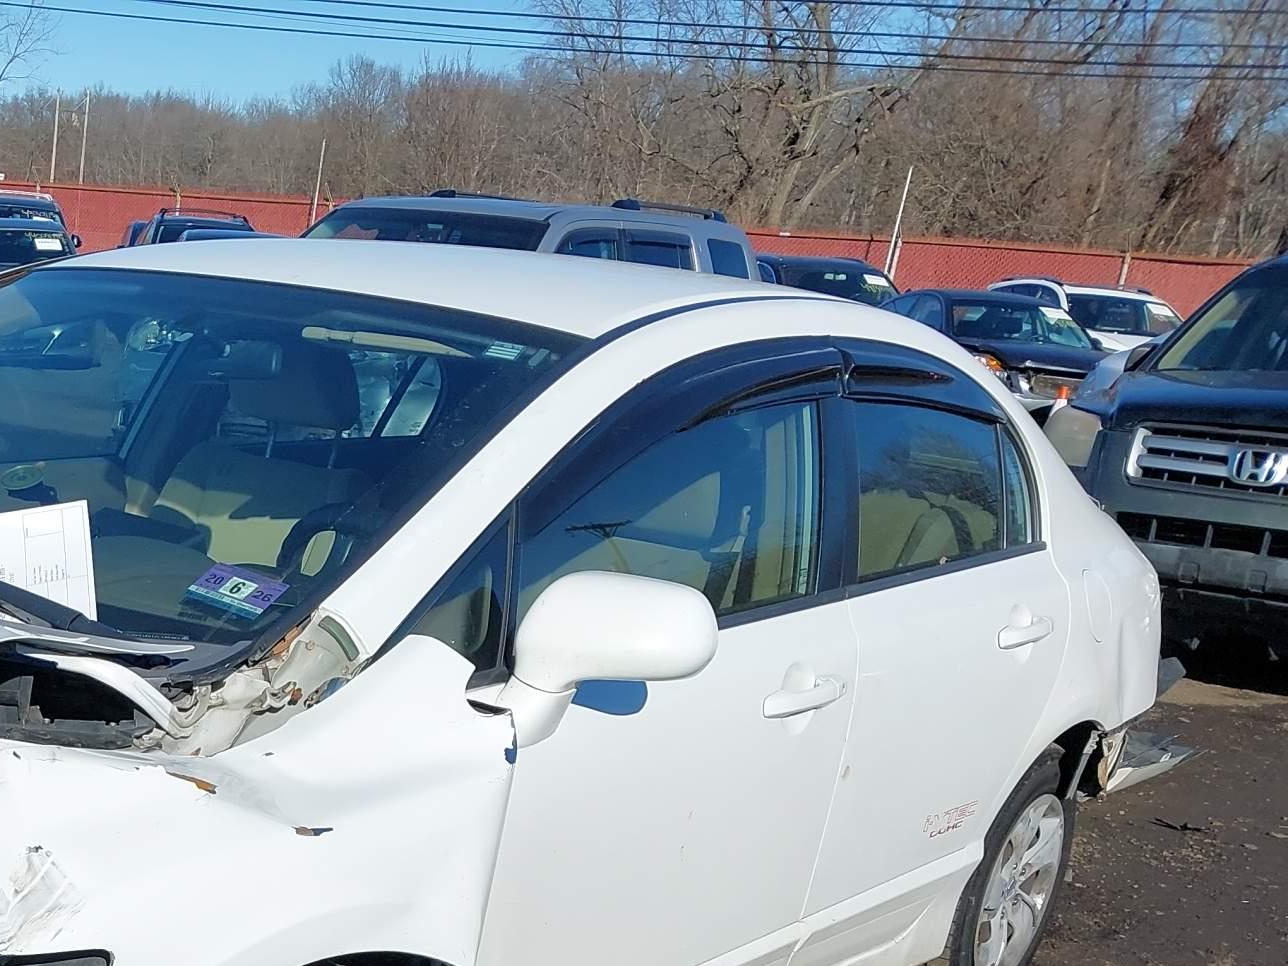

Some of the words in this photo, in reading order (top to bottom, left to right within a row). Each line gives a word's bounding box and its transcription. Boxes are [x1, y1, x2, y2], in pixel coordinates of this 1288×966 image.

[204, 574, 225, 586] 20
[229, 580, 246, 595] 6
[252, 590, 273, 602] 26
